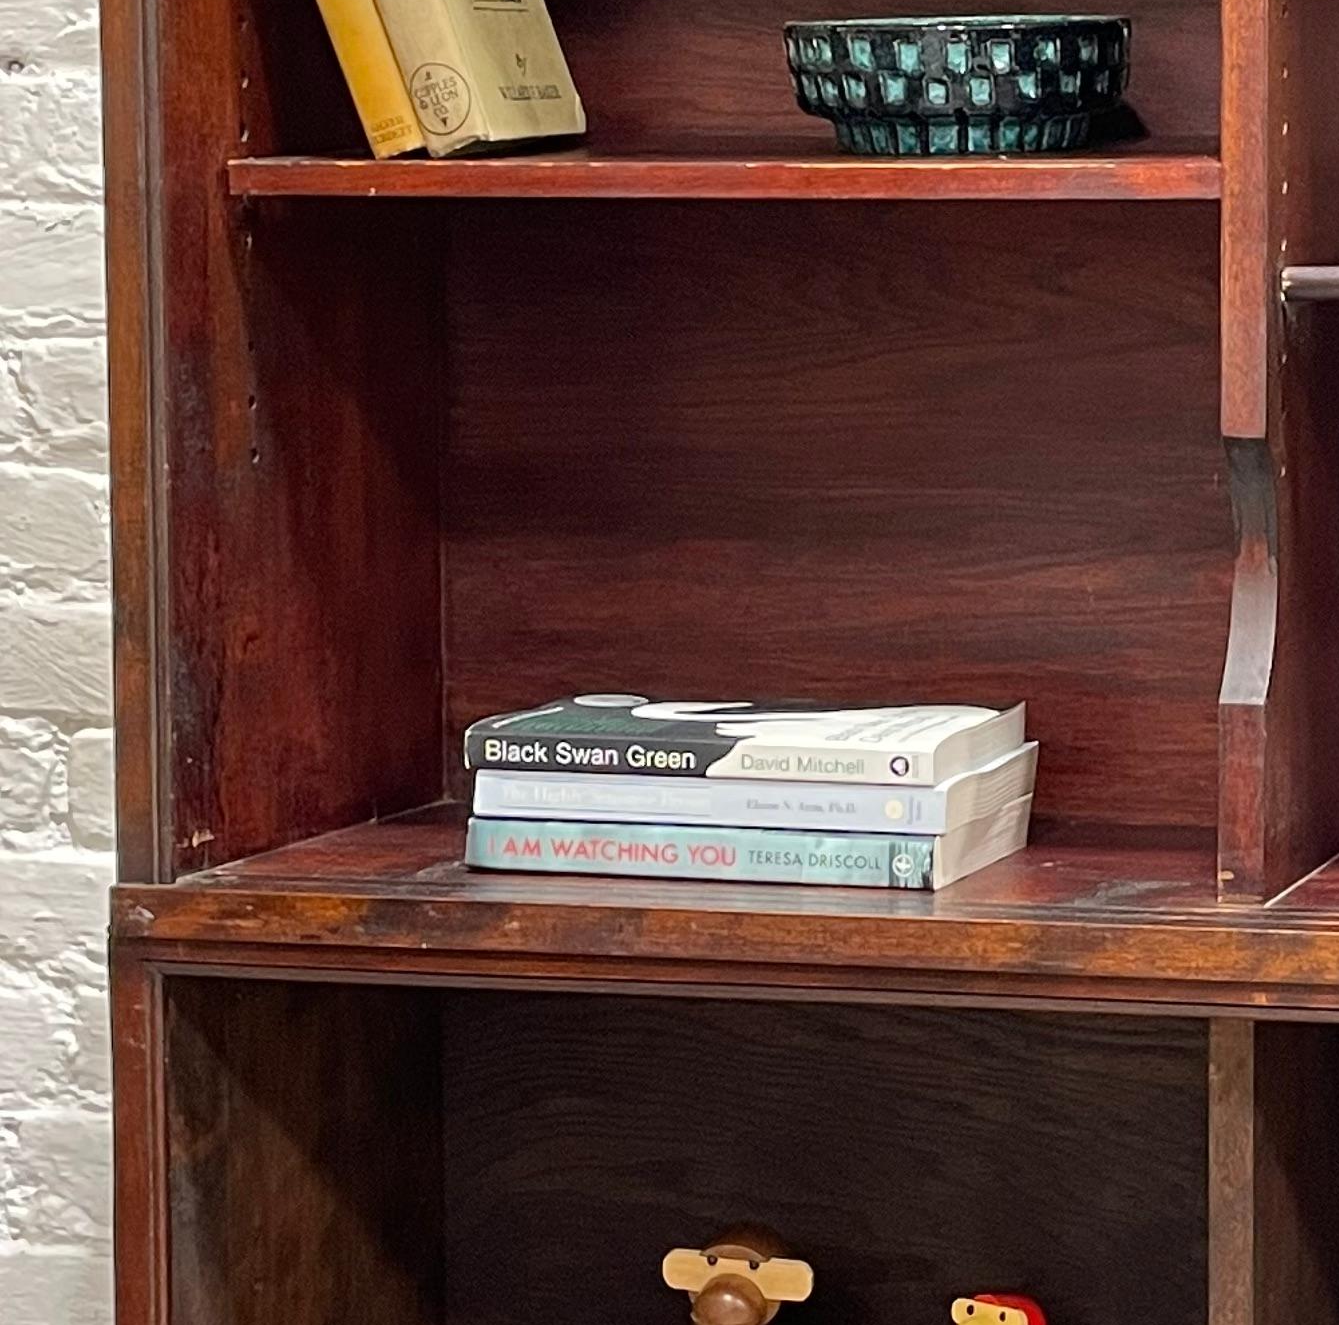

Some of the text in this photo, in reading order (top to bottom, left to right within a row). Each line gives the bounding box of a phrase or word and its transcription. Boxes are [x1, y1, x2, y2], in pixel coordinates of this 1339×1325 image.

[484, 739, 697, 770] Black Swan Green
[740, 753, 865, 775] David Mitchell
[489, 837, 736, 867] I AM WATCHING YOU
[748, 849, 883, 871] TERESA DRISCOLL
